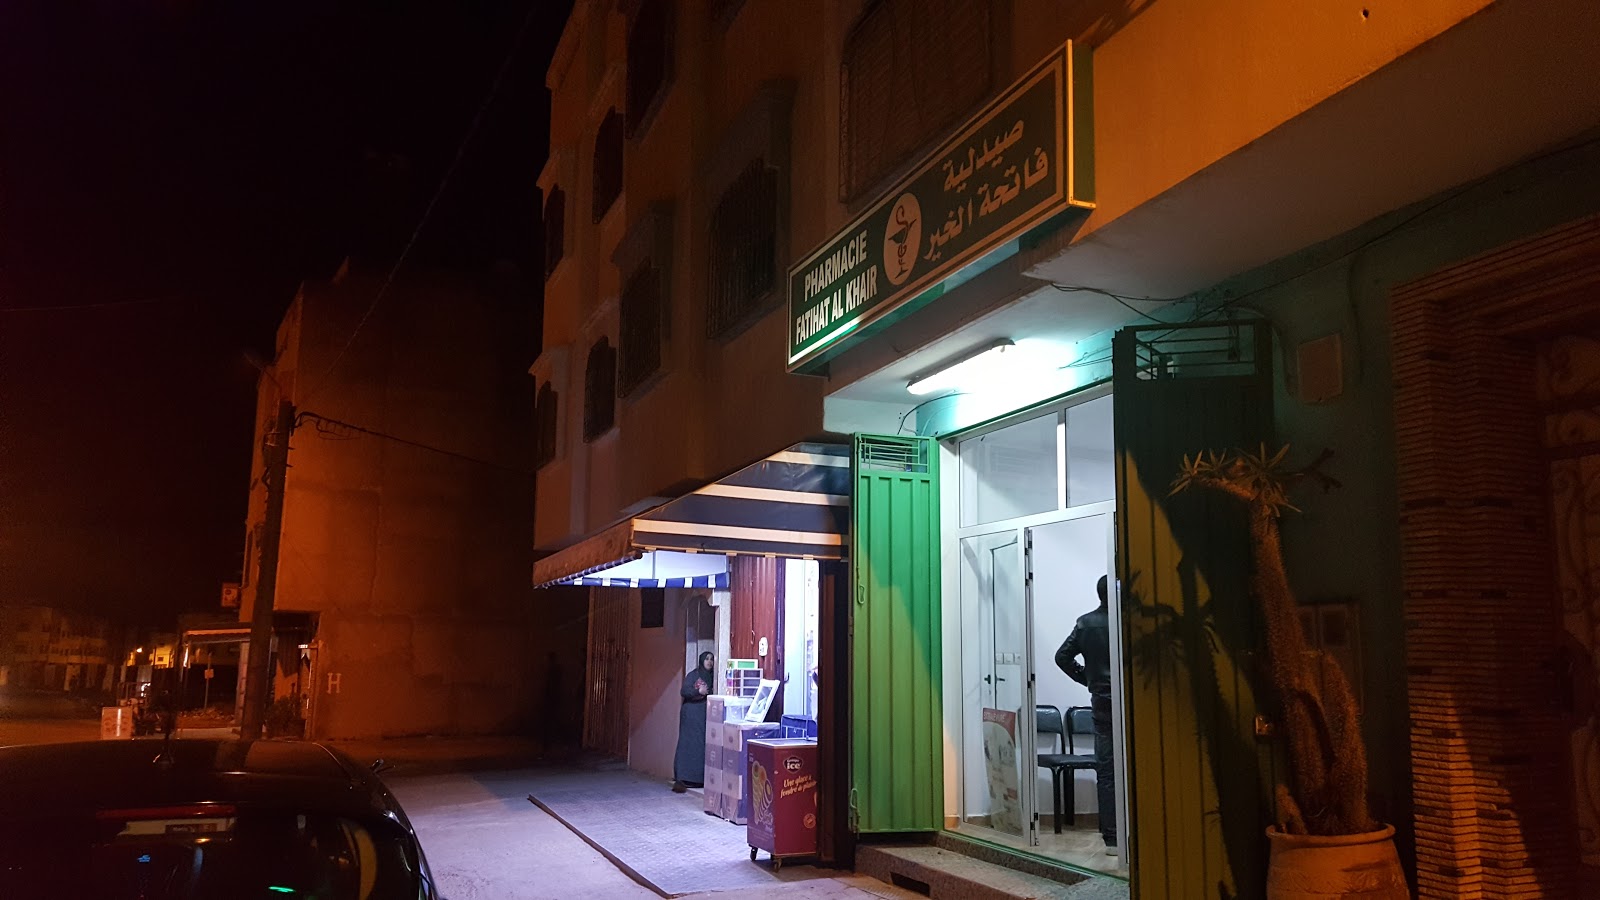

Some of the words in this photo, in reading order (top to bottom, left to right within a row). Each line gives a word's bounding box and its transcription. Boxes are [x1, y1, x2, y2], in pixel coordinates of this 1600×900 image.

[944, 120, 1024, 193] صيدلية
[978, 147, 1048, 219] فاتحة
[805, 230, 868, 302] PHARMACIE
[924, 199, 973, 261] الخير
[796, 305, 829, 345] FATIHAT
[831, 297, 844, 322] AL
[846, 270, 877, 314] KHAIR
[326, 672, 342, 694] H
[787, 762, 800, 770] ice
